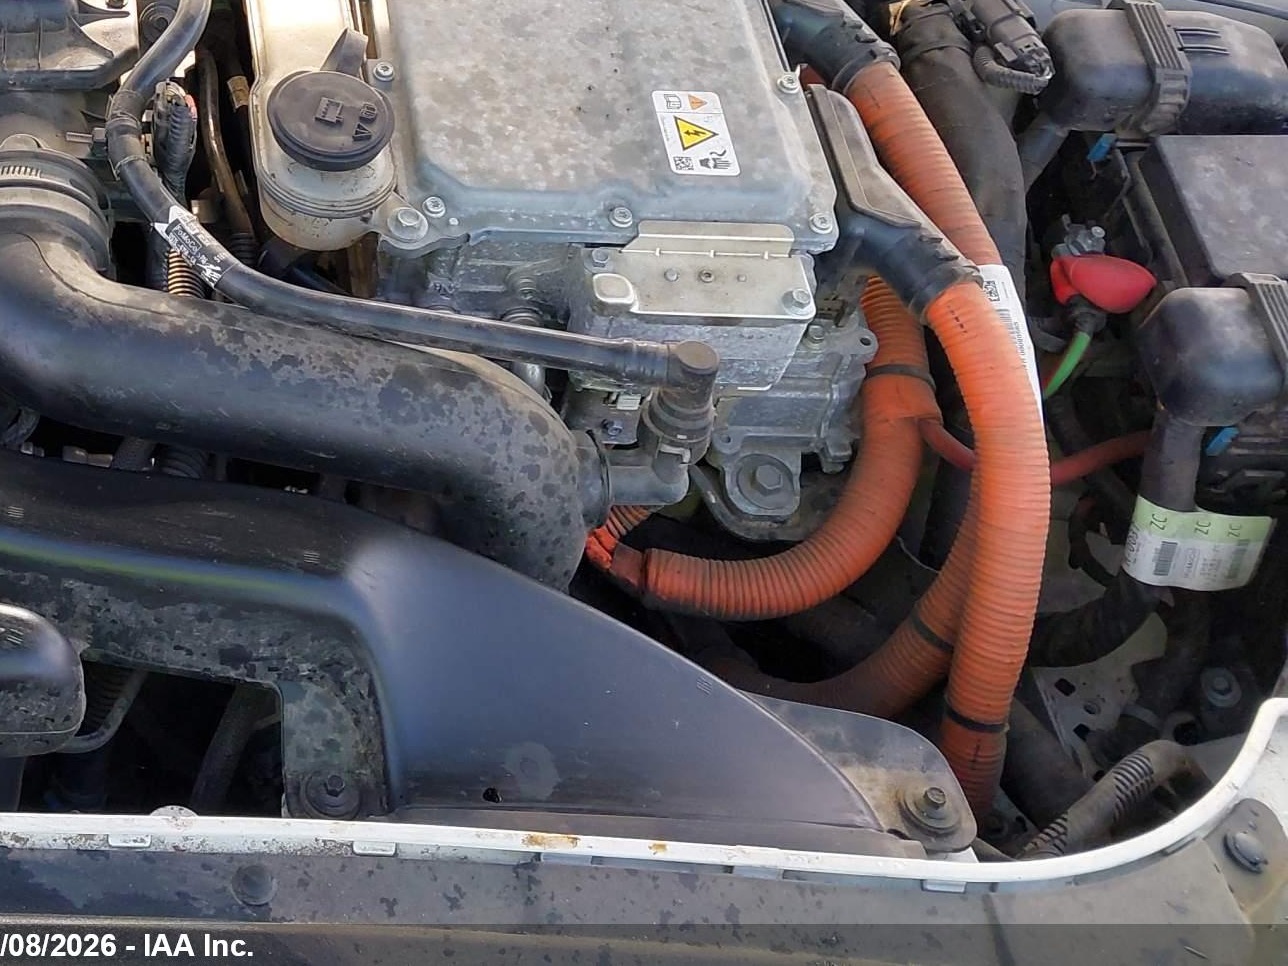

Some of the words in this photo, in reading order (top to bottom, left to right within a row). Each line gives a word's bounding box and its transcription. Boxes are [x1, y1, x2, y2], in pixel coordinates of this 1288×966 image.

[174, 224, 199, 253] FoMoCo
[1149, 513, 1168, 531] ZC
[1193, 520, 1212, 536] ZC
[1227, 522, 1243, 538] ZC
